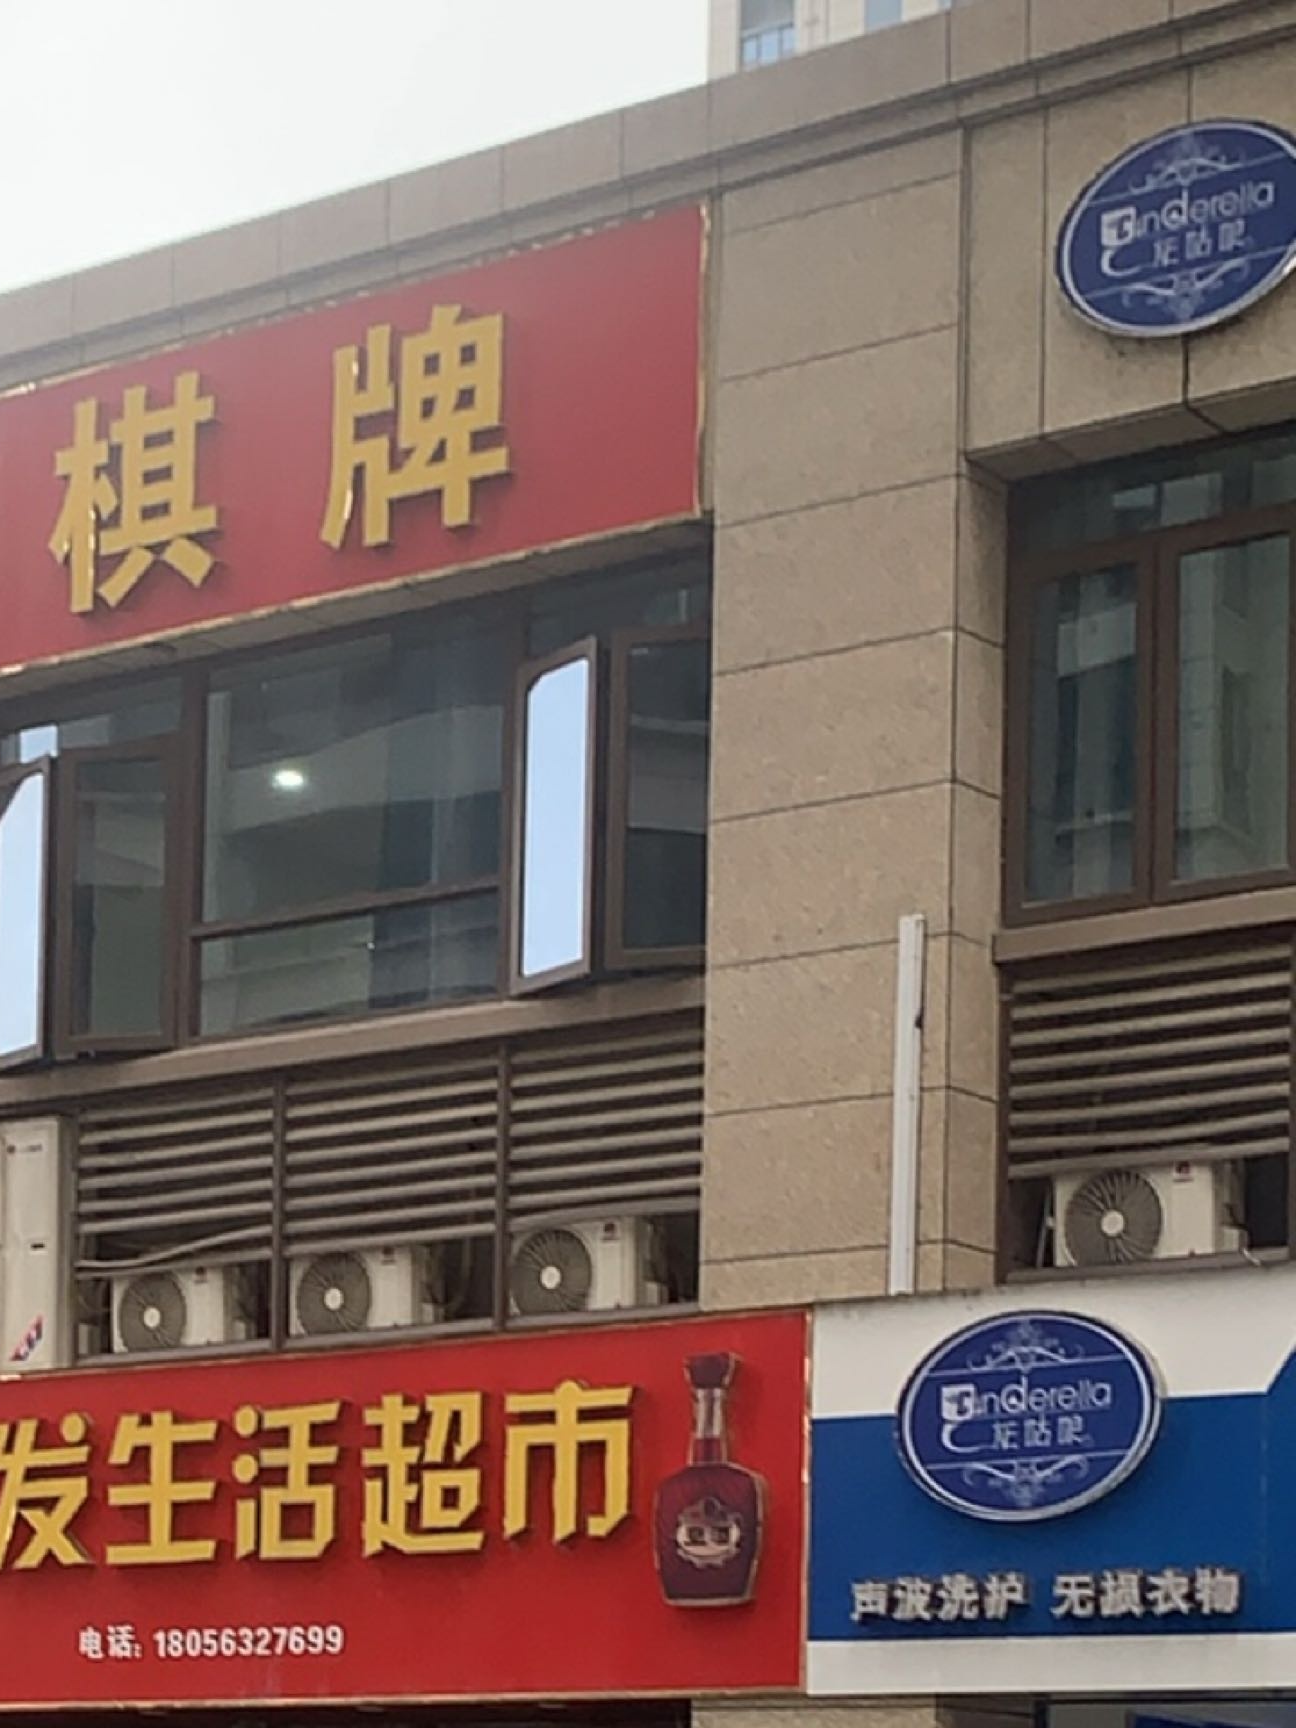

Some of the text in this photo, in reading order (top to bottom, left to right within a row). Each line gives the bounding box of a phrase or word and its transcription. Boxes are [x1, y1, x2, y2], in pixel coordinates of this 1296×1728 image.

[850, 1567, 1241, 1623] 声波洗护 无损衣物
[152, 1624, 345, 1659] 18056327699
